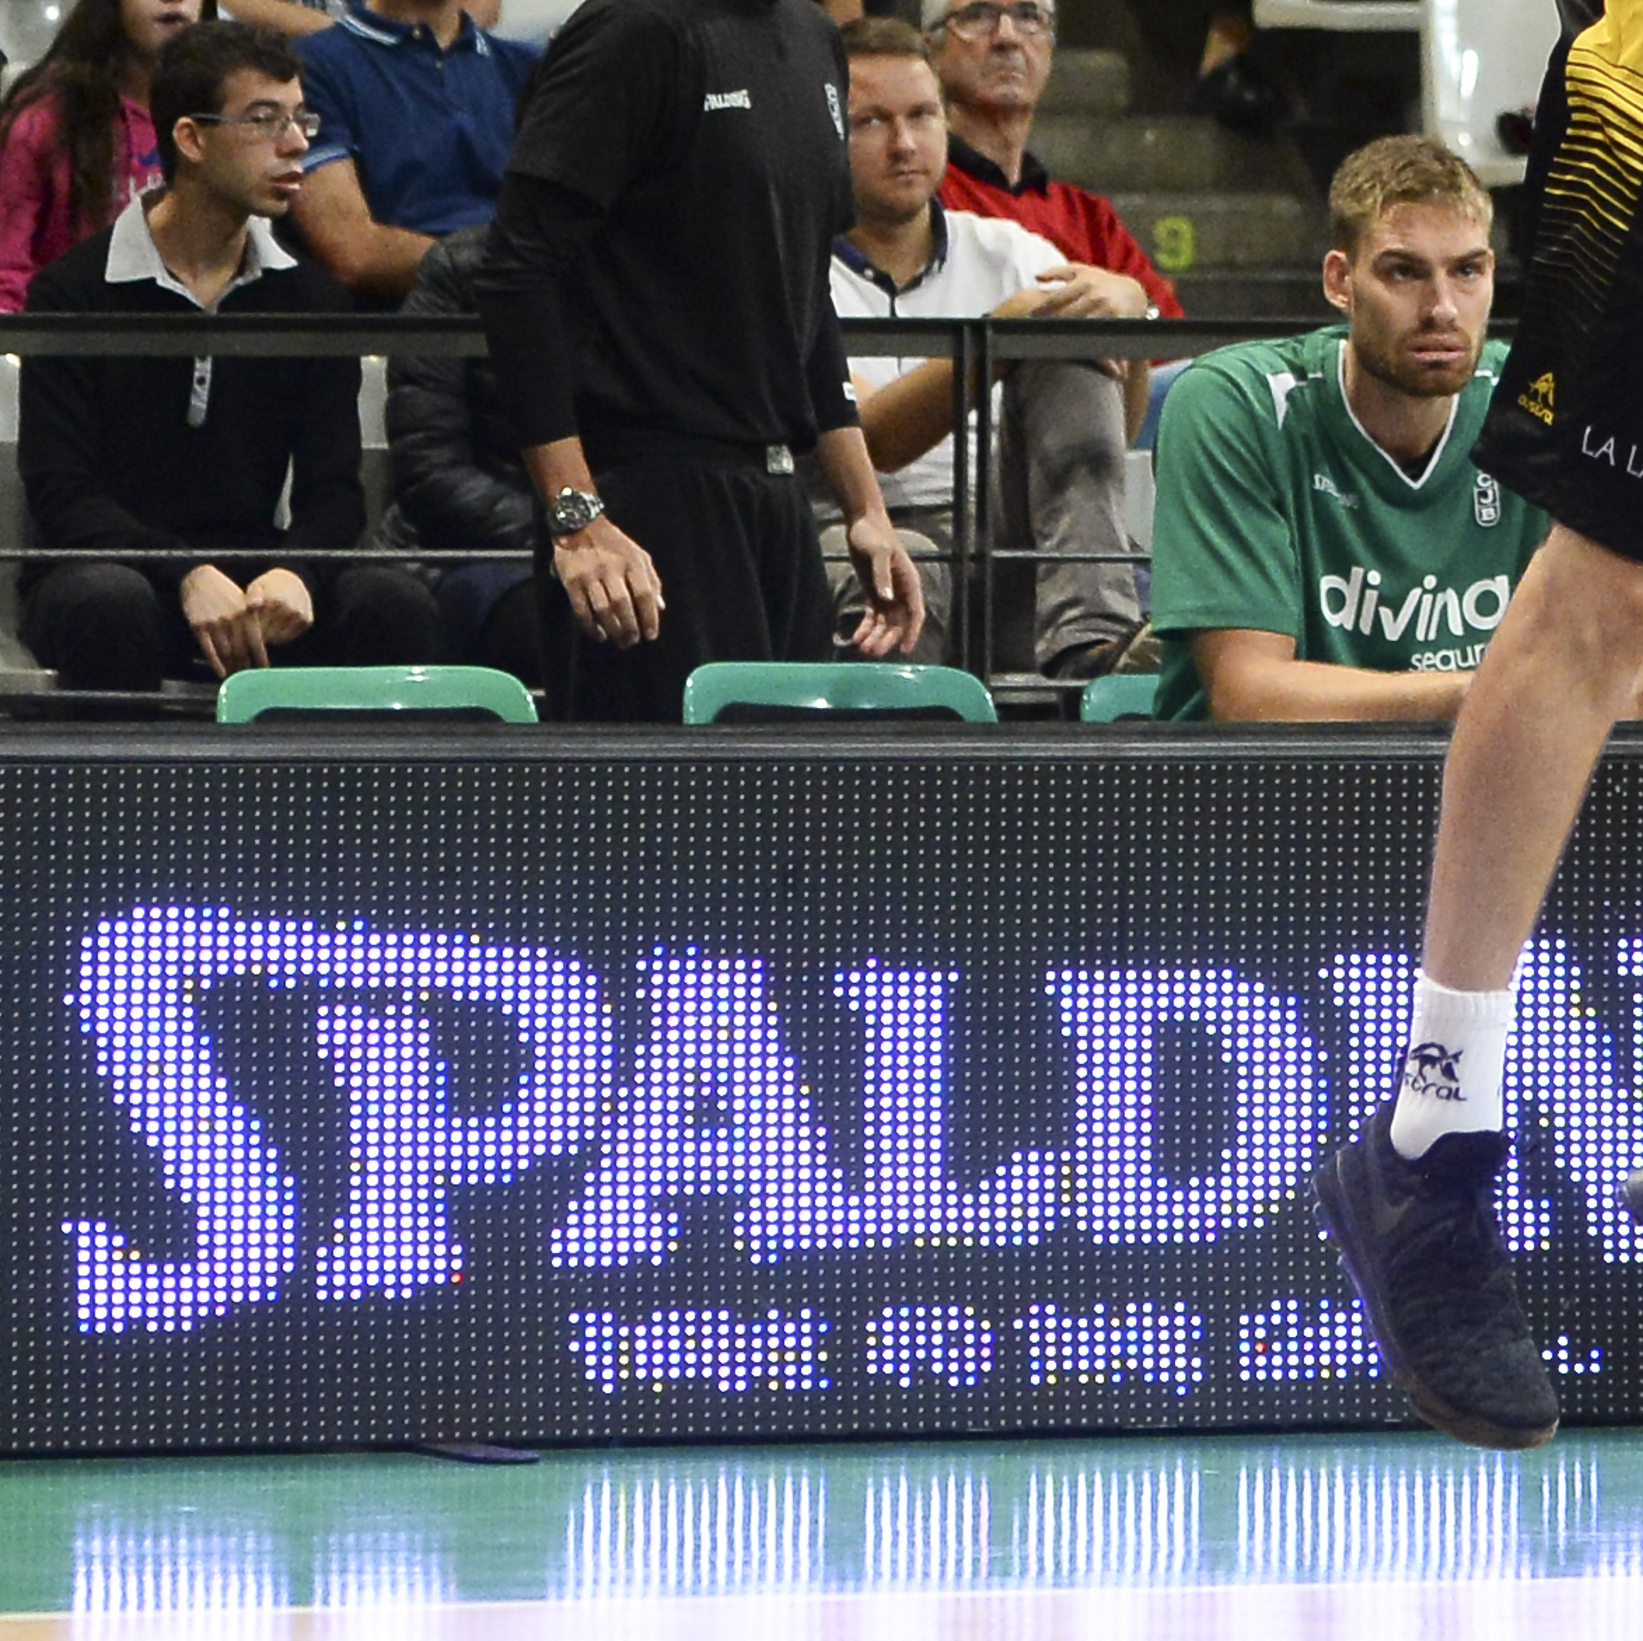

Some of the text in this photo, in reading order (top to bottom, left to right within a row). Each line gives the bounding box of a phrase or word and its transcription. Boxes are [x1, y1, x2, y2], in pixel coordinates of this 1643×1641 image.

[1153, 215, 1194, 270] 9
[1581, 424, 1616, 467] LA
[1320, 566, 1510, 642] divina
